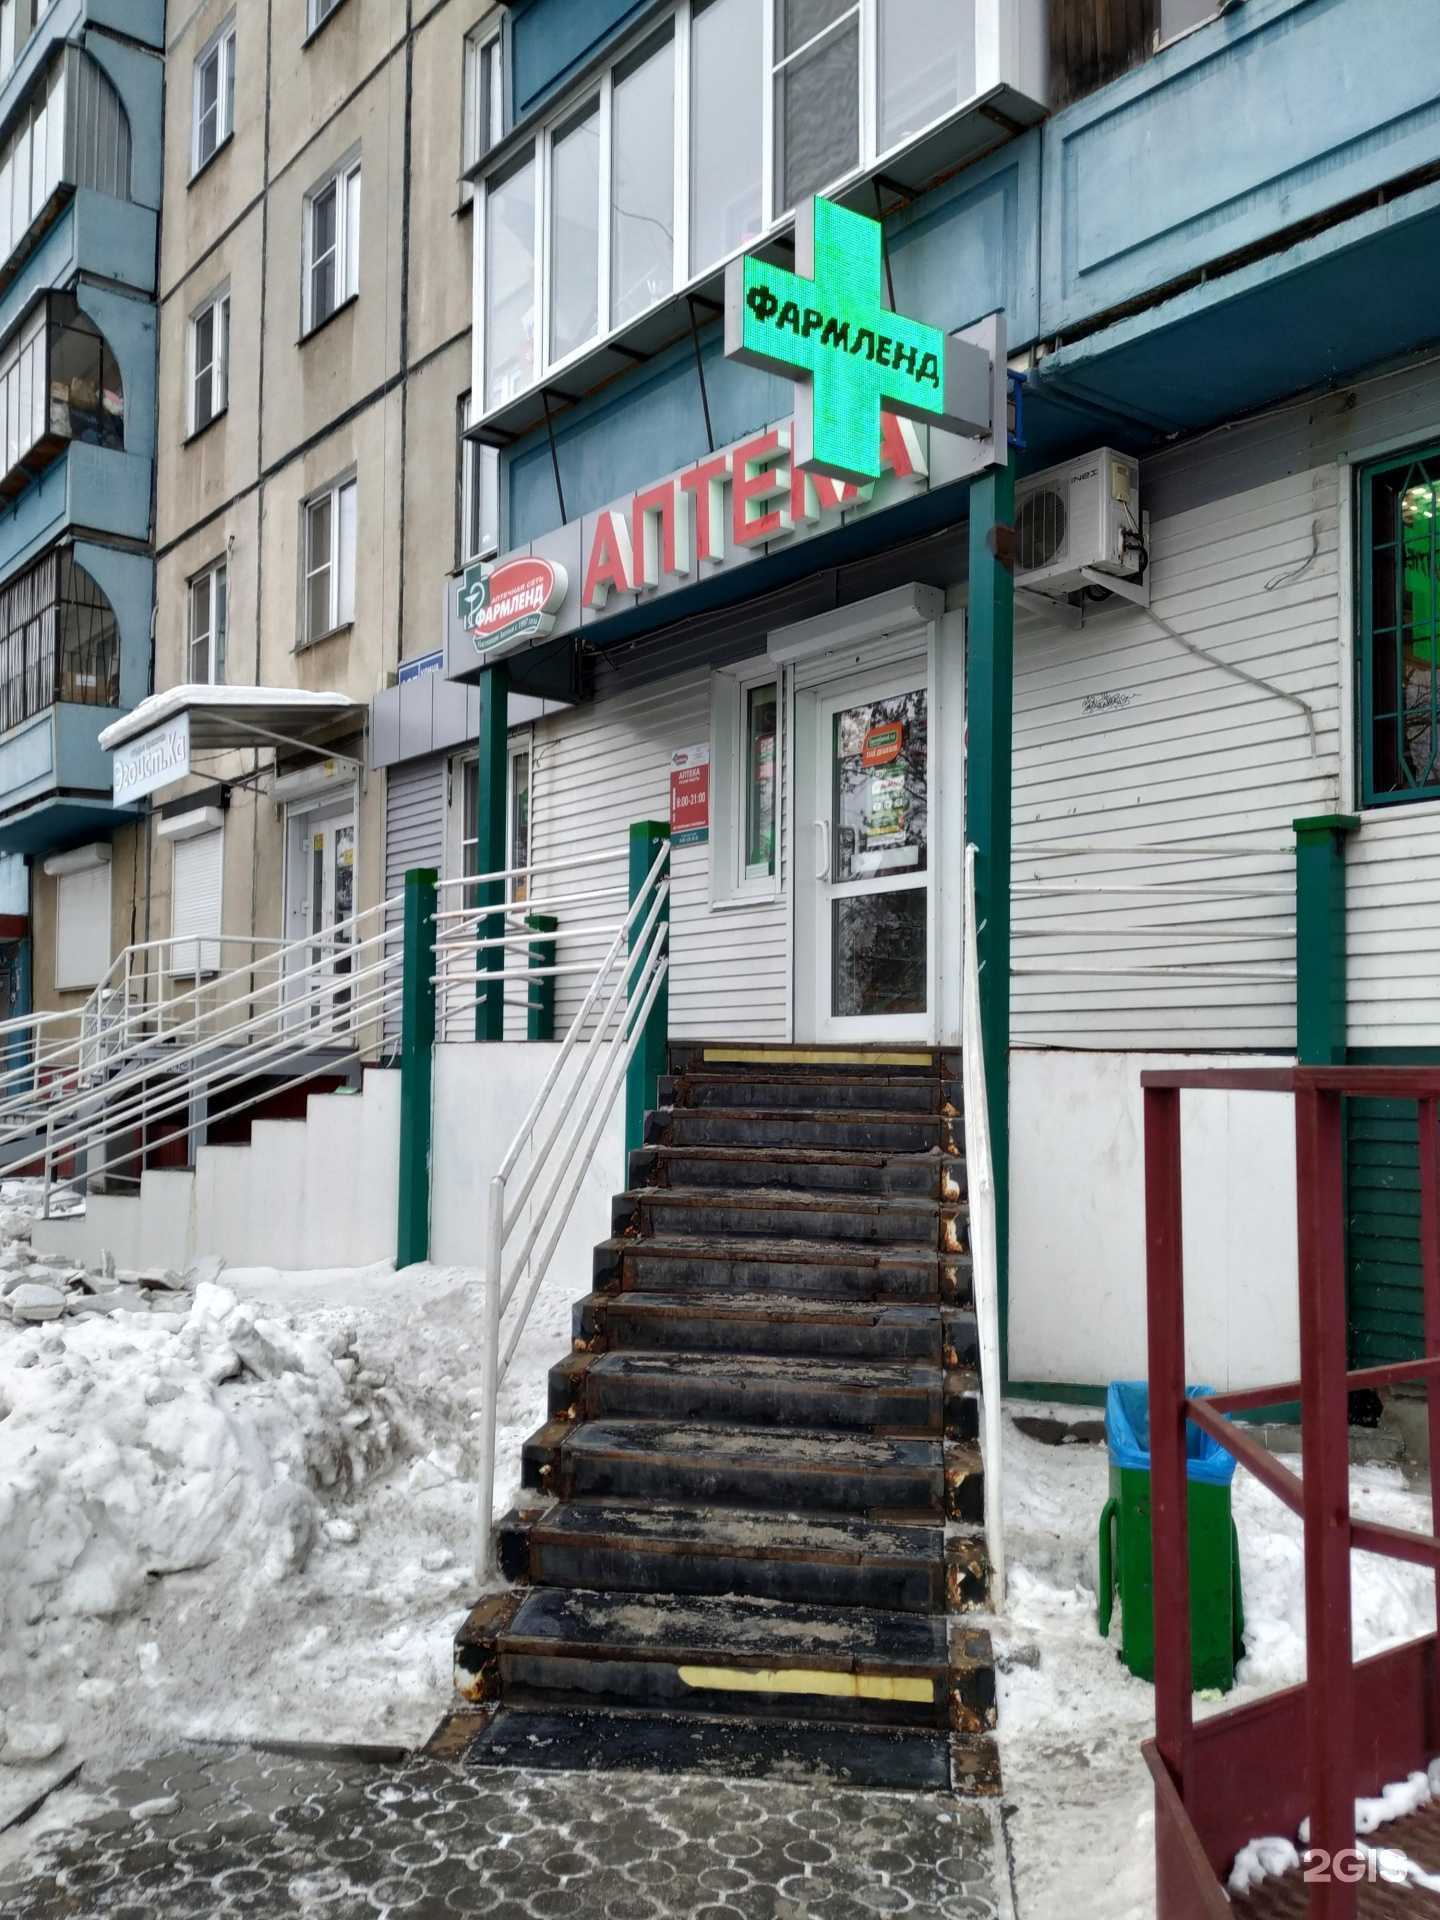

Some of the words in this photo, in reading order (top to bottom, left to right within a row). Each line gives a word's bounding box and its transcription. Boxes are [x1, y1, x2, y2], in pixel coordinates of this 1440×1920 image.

[747, 285, 939, 388] ФАРМЛЕНД
[475, 583, 544, 628] ФАРМЛЕНД
[678, 767, 700, 780] АПТЕКА
